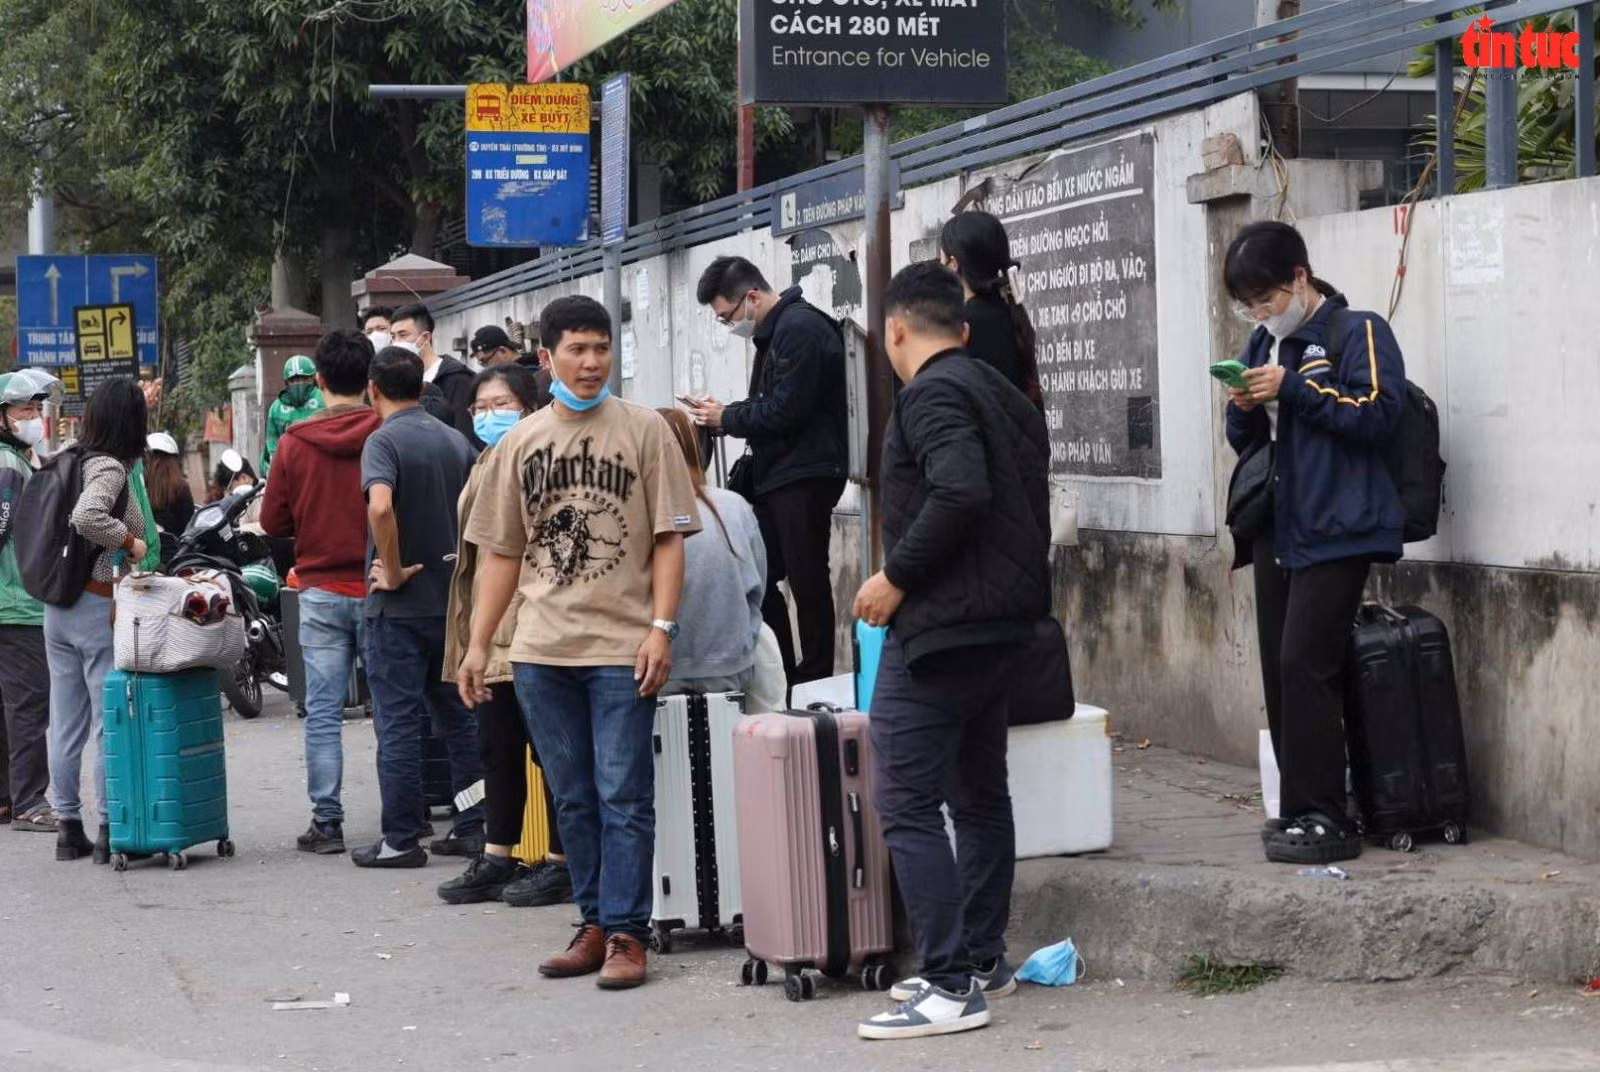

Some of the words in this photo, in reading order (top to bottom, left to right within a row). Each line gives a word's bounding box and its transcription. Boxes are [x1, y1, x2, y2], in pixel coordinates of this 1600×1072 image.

[770, 9, 841, 35] CÁCH
[848, 15, 890, 36] 280
[897, 11, 940, 36] MÉT
[771, 46, 870, 67] Entrance
[877, 47, 905, 67] for
[911, 47, 991, 68] Vehicle
[521, 112, 536, 123] XE
[1025, 183, 1045, 208] VÀO
[1064, 175, 1076, 198] XE
[1064, 223, 1090, 252] NGỌC
[1027, 270, 1047, 293] CHO
[1038, 306, 1049, 328] XE
[1084, 340, 1096, 360] XE
[1051, 366, 1076, 393] HÀNH
[1129, 367, 1143, 390] XE
